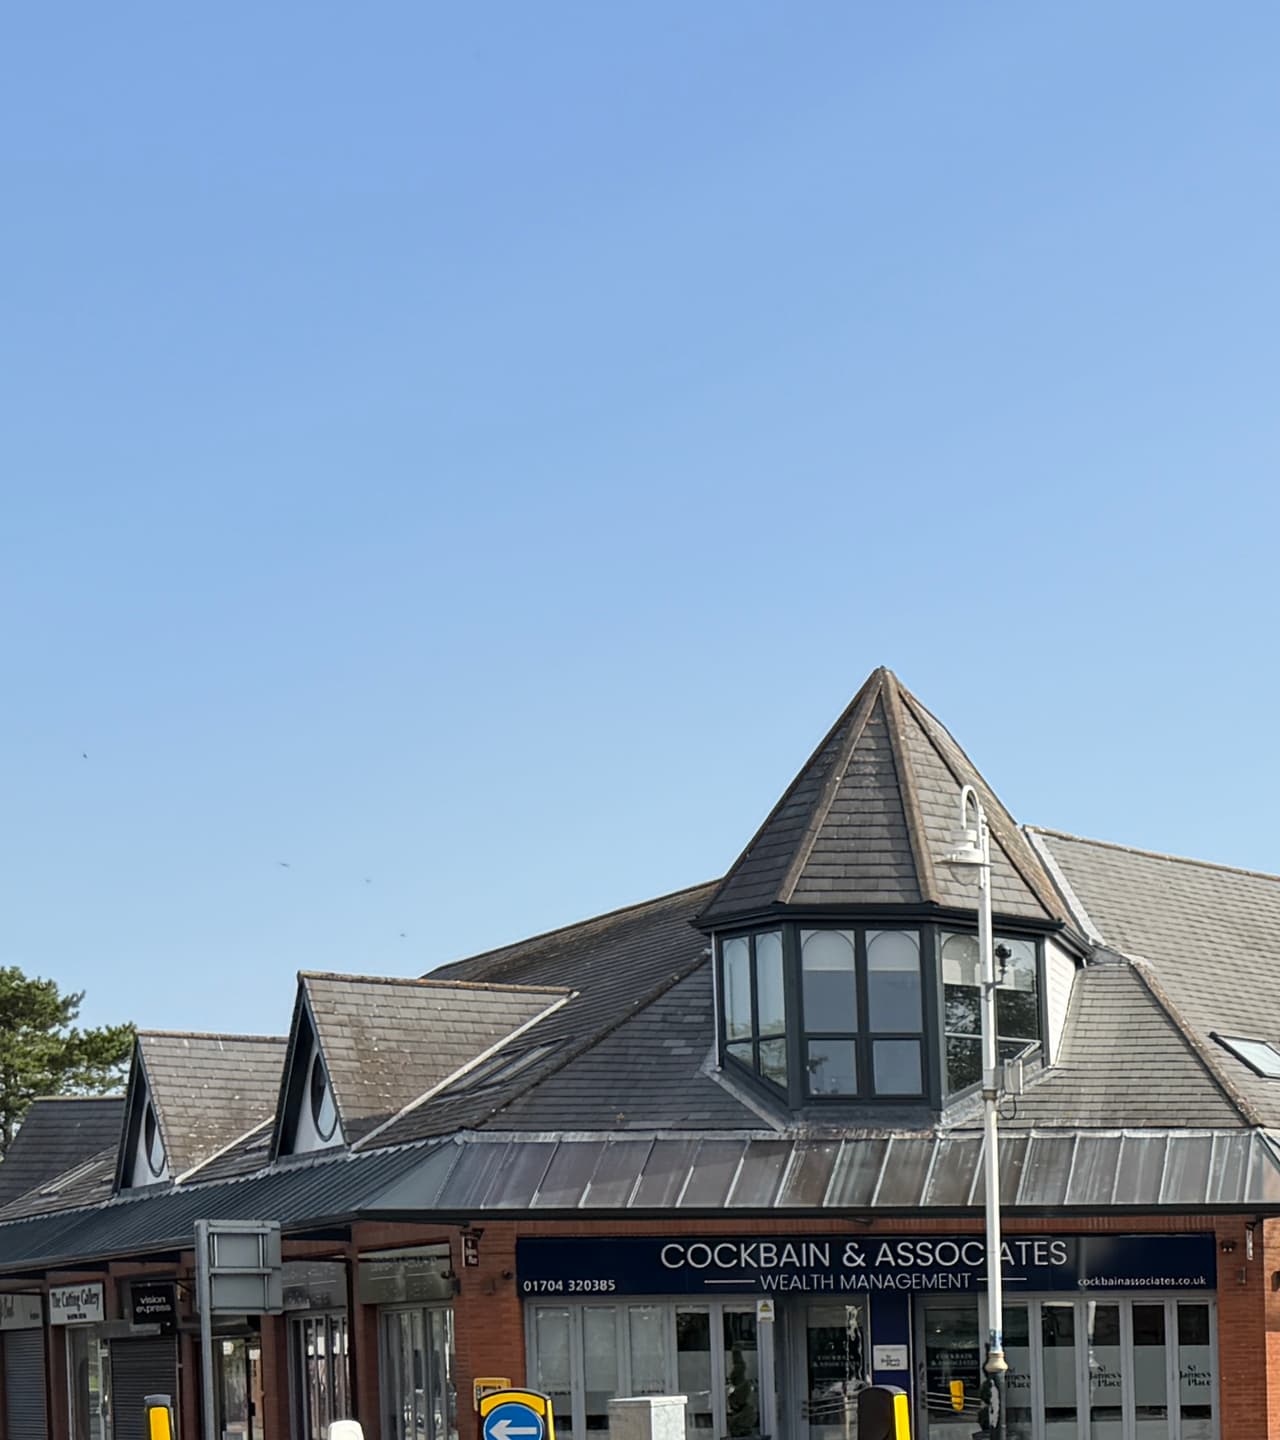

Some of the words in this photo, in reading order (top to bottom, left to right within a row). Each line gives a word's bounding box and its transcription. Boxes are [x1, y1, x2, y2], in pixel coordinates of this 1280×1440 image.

[661, 1242, 830, 1269] COCKBAIN
[843, 1242, 866, 1268] &
[875, 1240, 1068, 1268] ASSOCATES
[524, 1280, 563, 1292] 01704
[568, 1279, 616, 1292] 320385
[760, 1274, 834, 1291] WEALTH
[839, 1273, 971, 1290] MANAGEMENT
[1077, 1275, 1208, 1286] cockbainassociates.co.uk
[51, 1291, 62, 1308] The
[140, 1295, 166, 1304] vision
[136, 1303, 172, 1314] express
